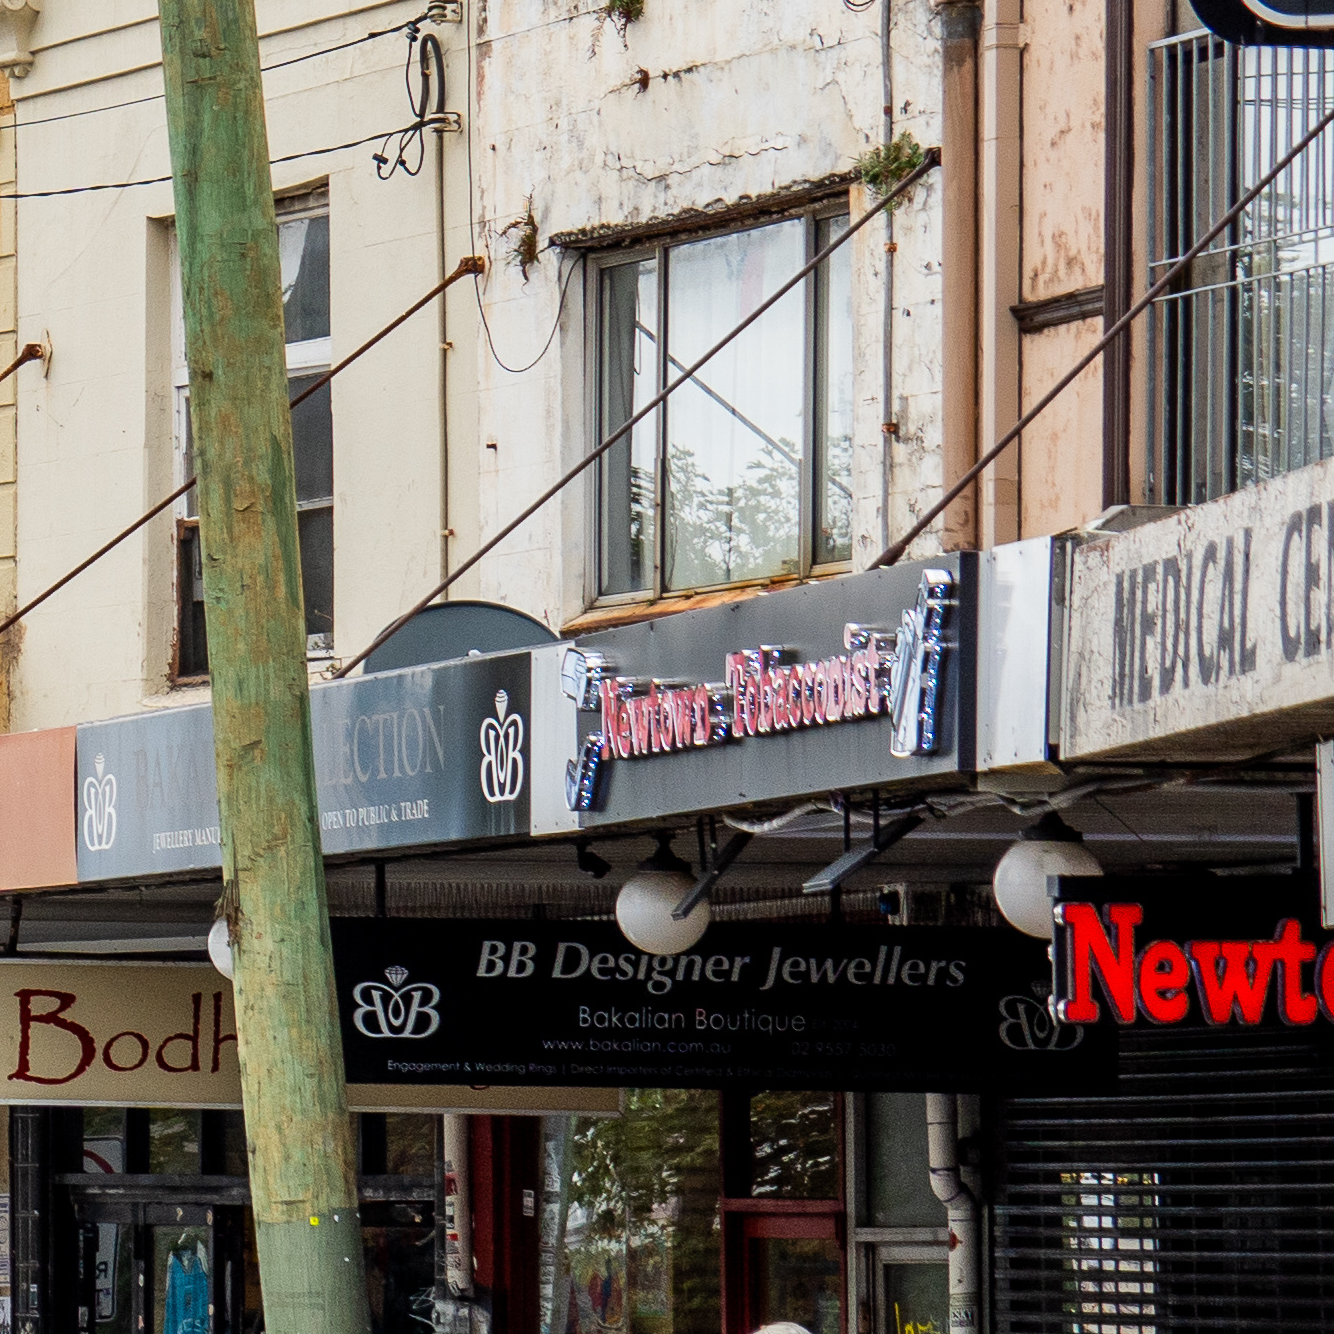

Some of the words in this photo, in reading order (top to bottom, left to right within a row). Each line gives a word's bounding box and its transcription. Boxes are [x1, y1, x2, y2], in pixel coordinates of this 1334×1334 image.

[1110, 526, 1258, 711] MEDICAL
[1279, 498, 1334, 663] CE
[322, 808, 343, 831] OPEN
[345, 808, 357, 828] TO
[358, 803, 390, 826] PUBLIC
[390, 804, 399, 823] &
[400, 799, 430, 820] TRADE
[474, 939, 538, 979] BB
[550, 940, 752, 996] Designer
[758, 944, 968, 992] Jewellers
[1054, 901, 1334, 1026] Newt
[577, 1005, 686, 1031] Bakalian
[694, 1006, 807, 1037] Boutique
[541, 1038, 733, 1056] www.bakalian.com.au
[386, 1059, 460, 1074] Engagement
[463, 1060, 472, 1072] &
[474, 1061, 526, 1075] Wedding
